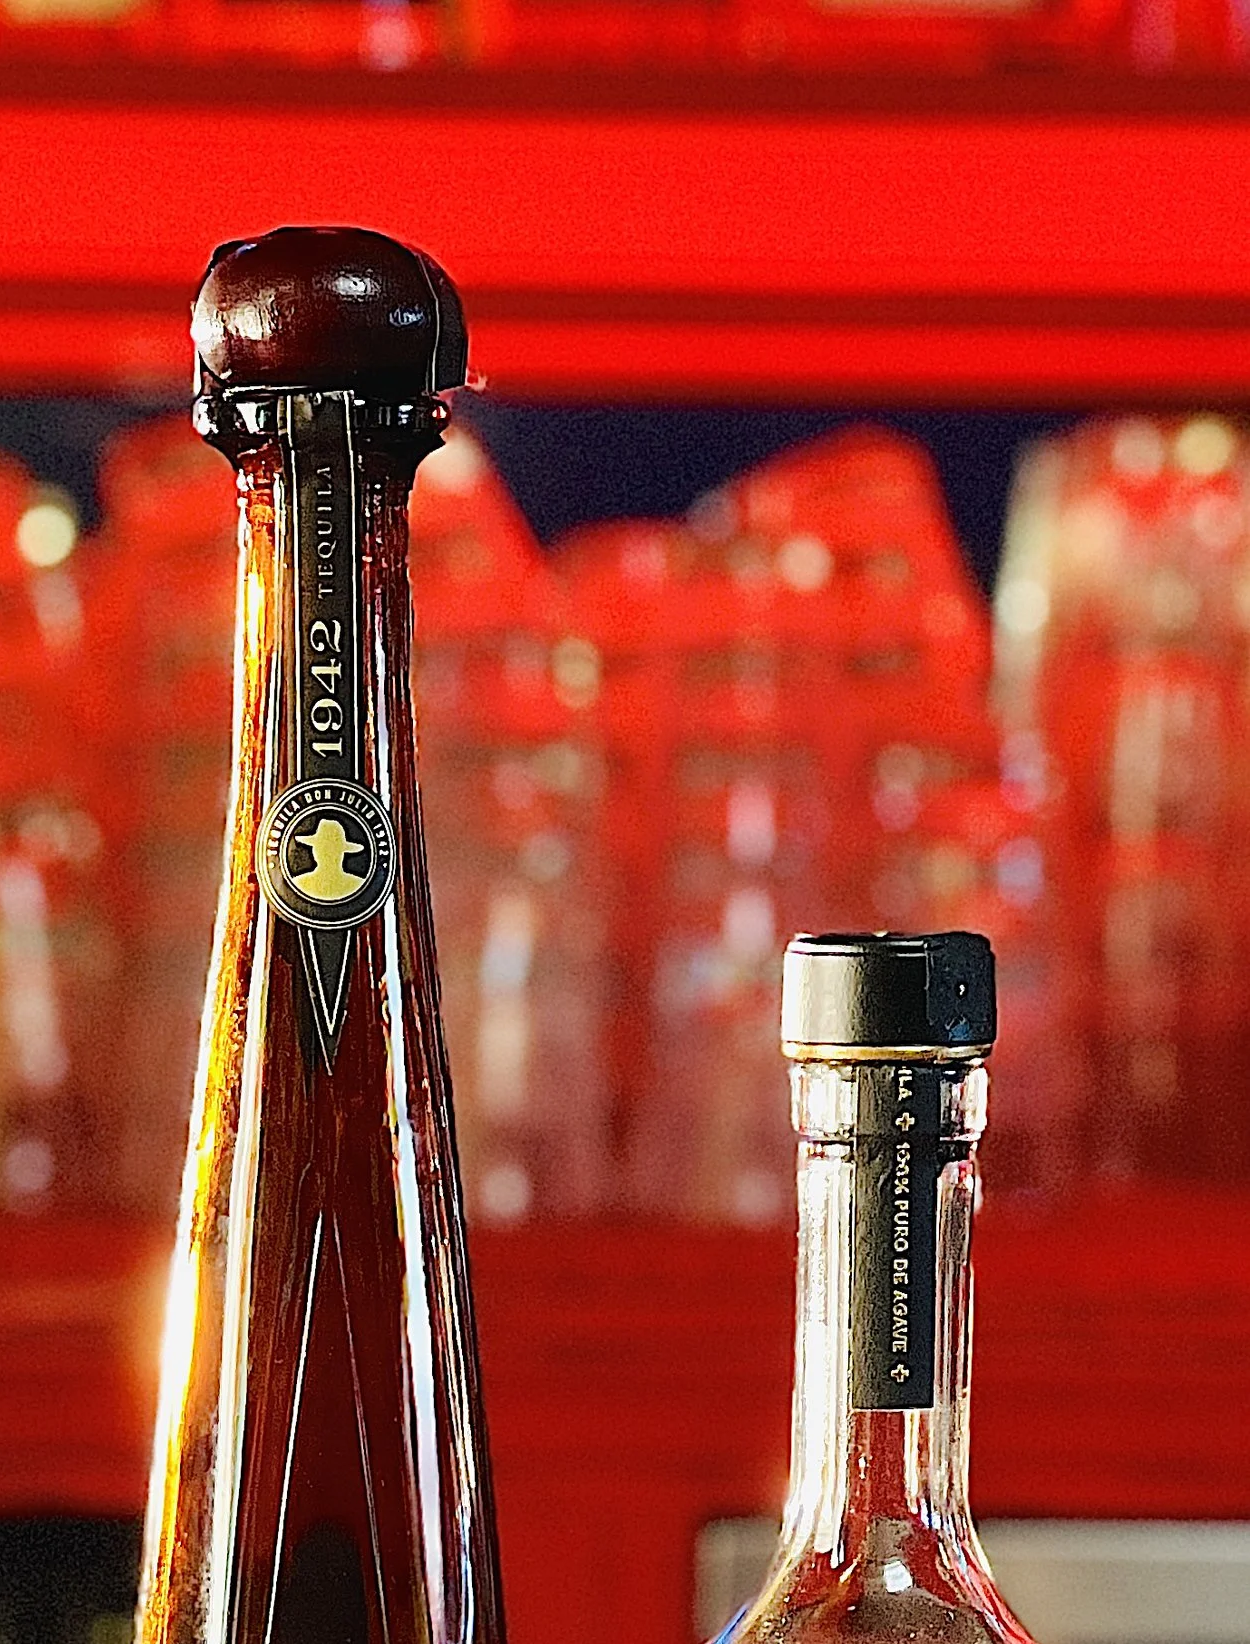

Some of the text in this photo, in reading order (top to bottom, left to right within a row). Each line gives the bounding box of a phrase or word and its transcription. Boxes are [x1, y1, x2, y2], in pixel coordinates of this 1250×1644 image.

[311, 466, 343, 758] 1942 TEQUILA
[266, 789, 390, 857] TEQUILA DON JULIO 1942
[897, 1066, 913, 1101] ILA
[893, 1200, 910, 1252] PURO
[892, 1259, 909, 1285] DE
[891, 1290, 909, 1353] AGAVE
